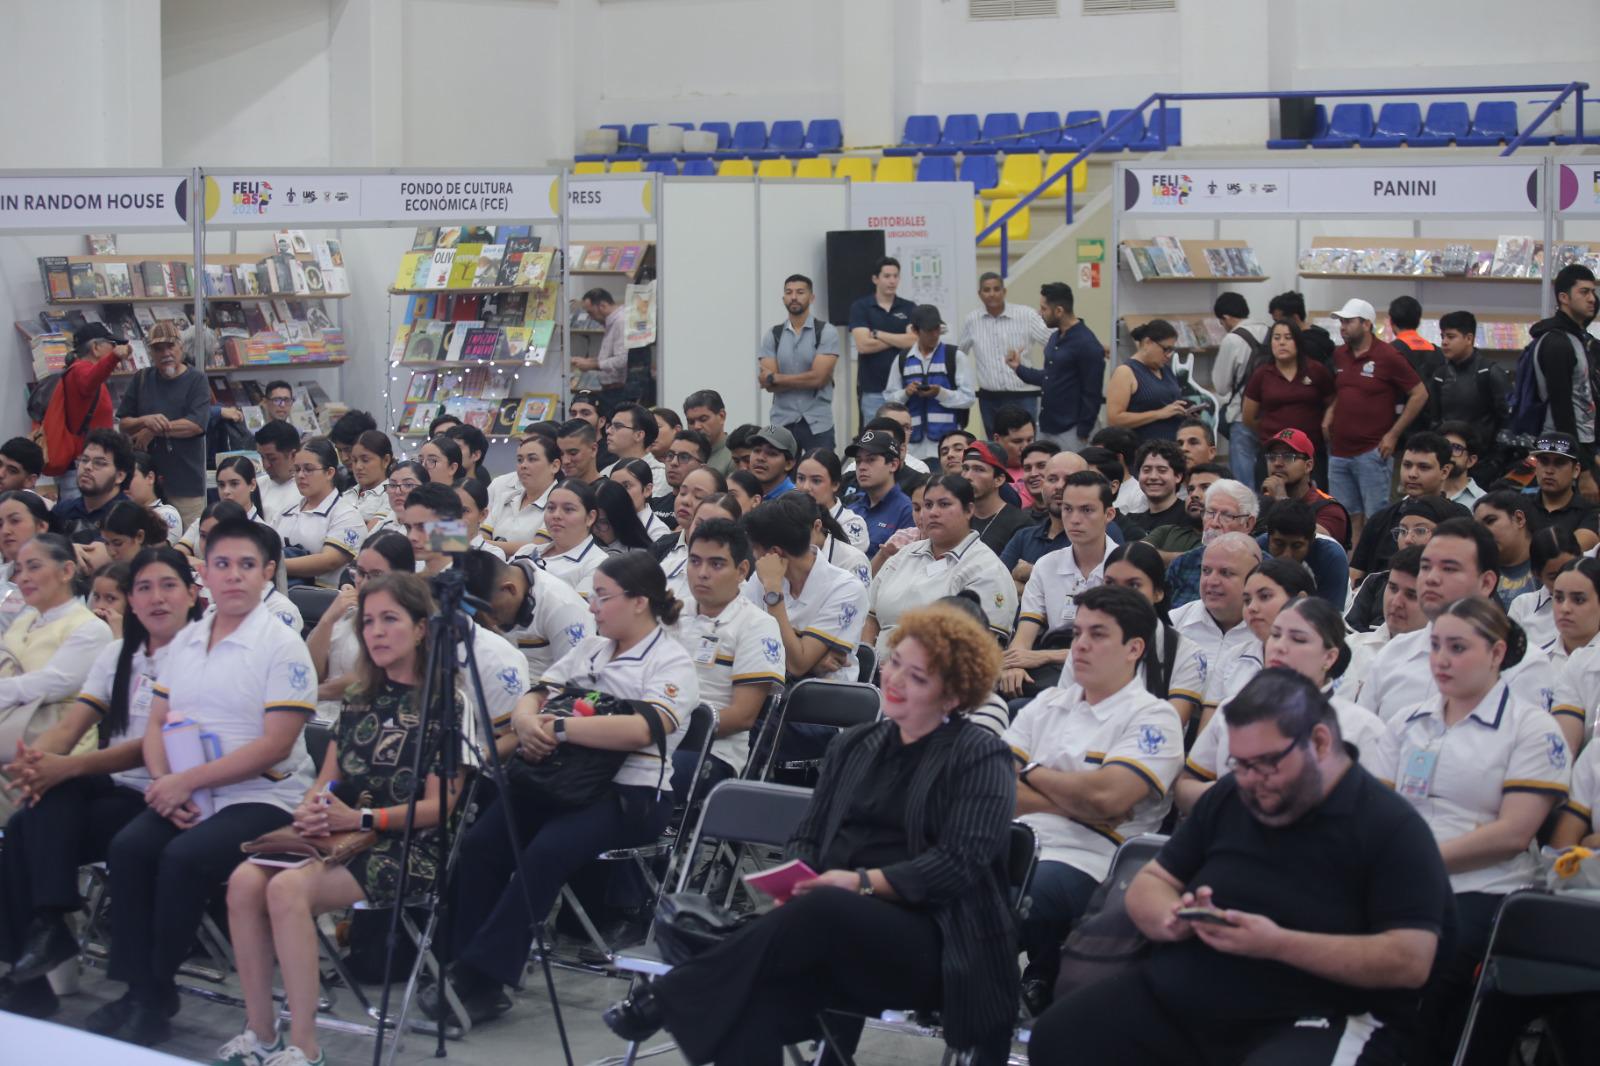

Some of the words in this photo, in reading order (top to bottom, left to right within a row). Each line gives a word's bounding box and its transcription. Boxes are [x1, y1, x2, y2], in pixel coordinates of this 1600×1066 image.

[1152, 174, 1178, 186] FELI
[232, 181, 259, 194] FELI
[400, 182, 443, 195] FONDO
[446, 182, 461, 195] DE
[463, 181, 513, 195] CULTURA
[1373, 180, 1436, 196] PANINI
[1, 194, 18, 211] IN
[24, 193, 102, 210] RANDOM
[107, 193, 165, 209] HOUSE
[404, 196, 477, 212] ECONÓMICA
[480, 196, 509, 212] (FCE)
[868, 215, 926, 228] EDITORIALES
